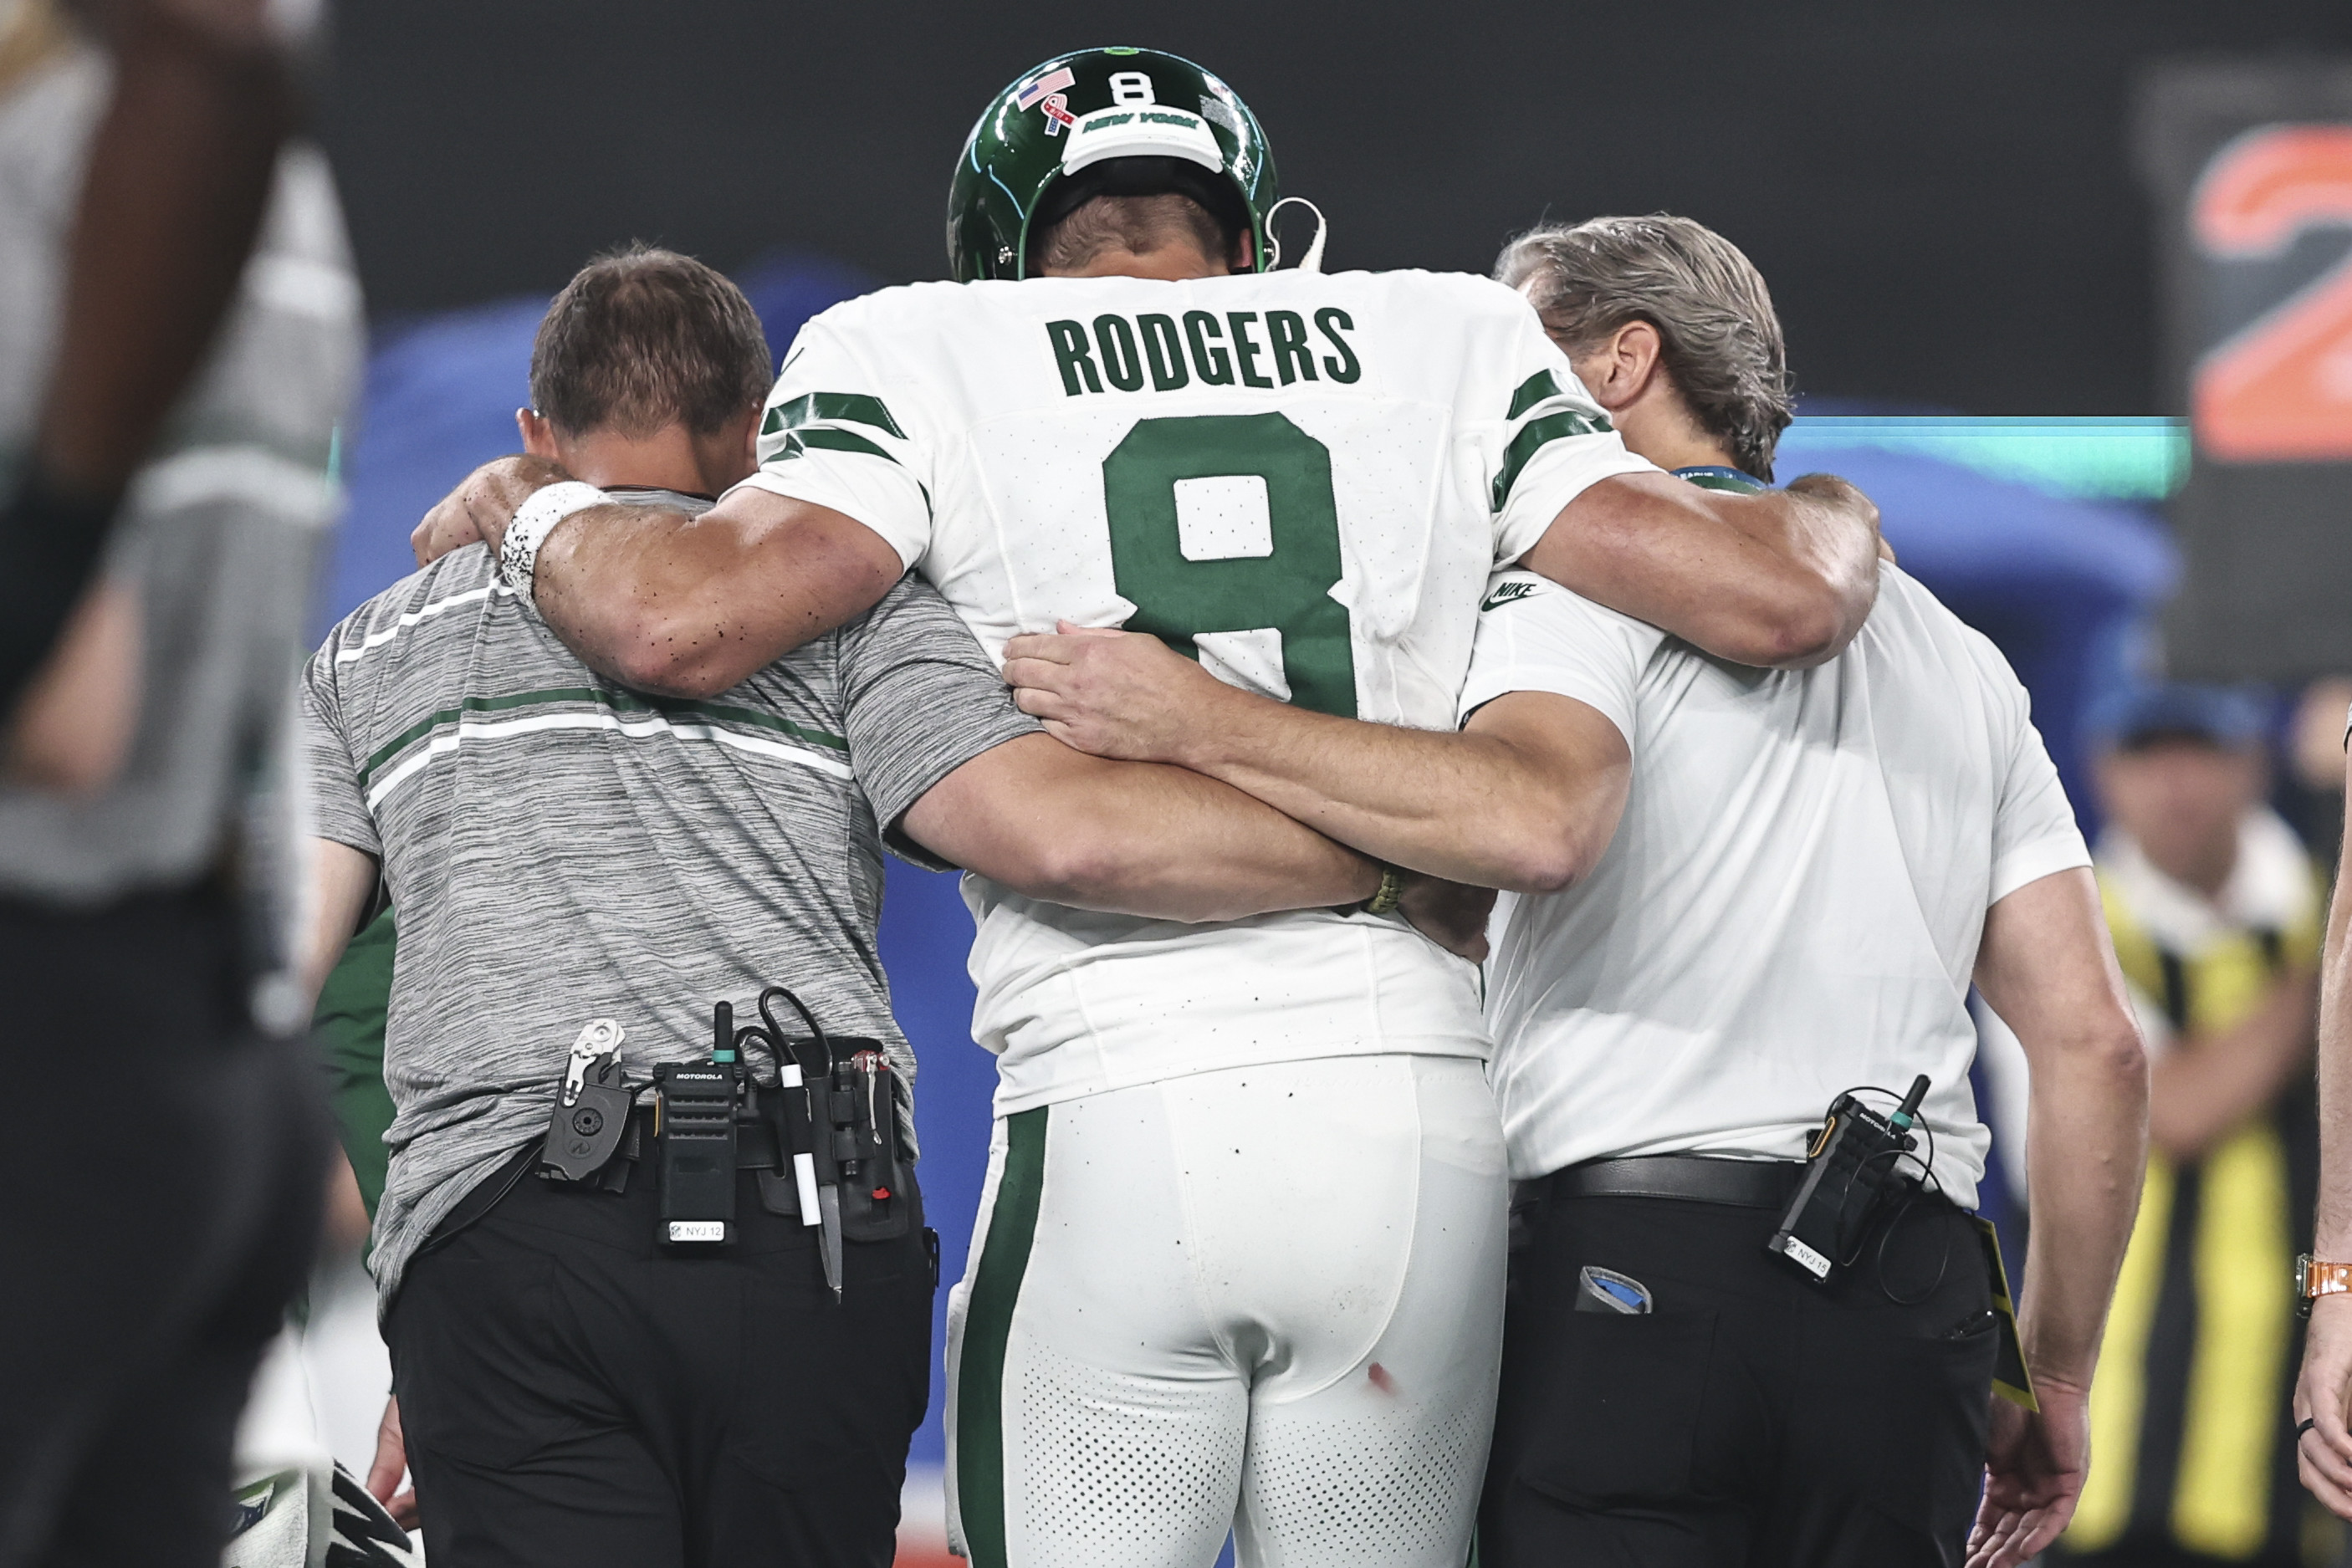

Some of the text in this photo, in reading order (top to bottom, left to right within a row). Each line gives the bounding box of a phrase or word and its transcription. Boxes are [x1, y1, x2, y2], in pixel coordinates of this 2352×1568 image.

[1108, 71, 1156, 105] 8
[1082, 113, 1199, 134] NEW YORK
[1046, 307, 1362, 396] RODGERS
[1102, 411, 1358, 720] 8
[1492, 582, 1537, 598] NIKE
[687, 1227, 721, 1236] NYJ 12
[1797, 1249, 1827, 1272] NYJ 15
